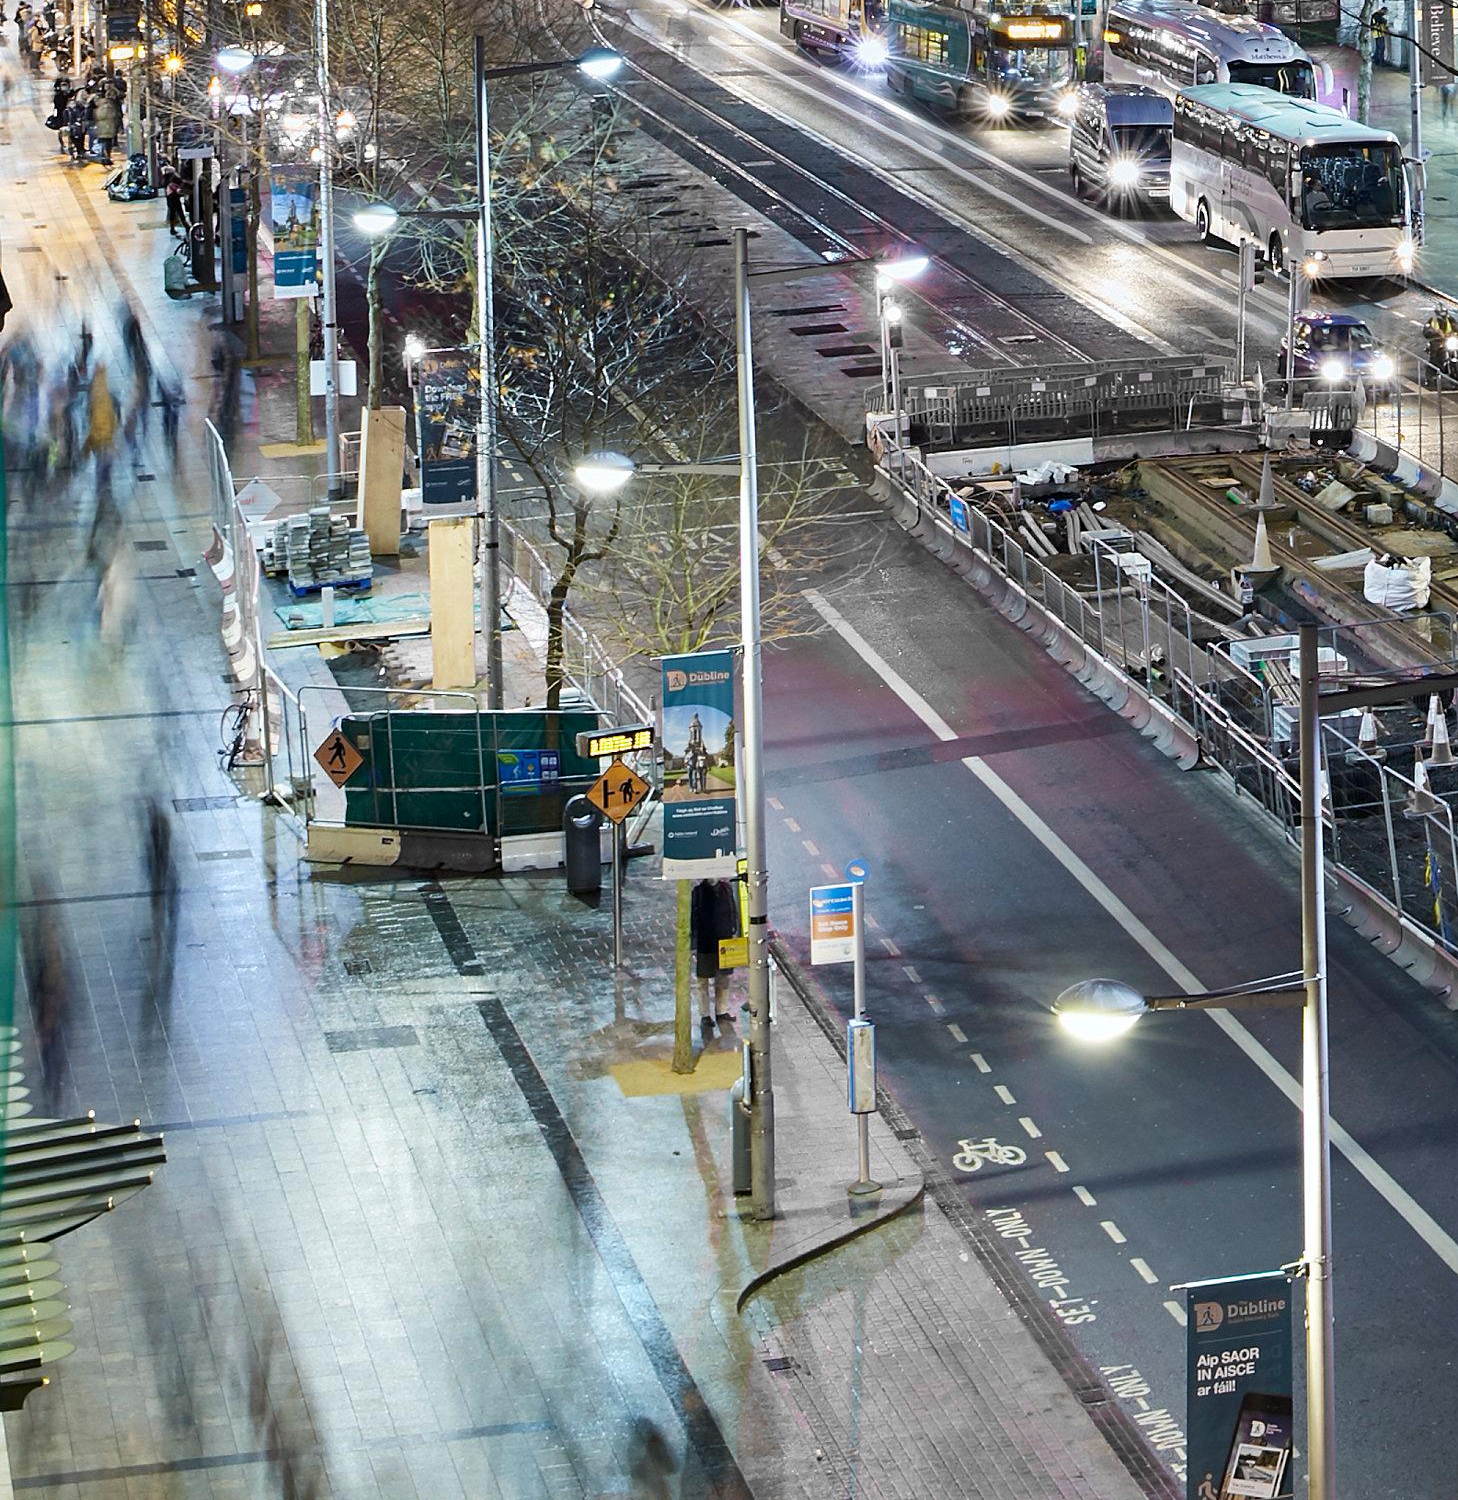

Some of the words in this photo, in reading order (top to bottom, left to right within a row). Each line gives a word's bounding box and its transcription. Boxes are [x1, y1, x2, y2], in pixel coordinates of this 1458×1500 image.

[1227, 1299, 1286, 1318] Dubline
[1196, 1354, 1219, 1367] Aip
[1221, 1347, 1260, 1364] SAOR
[1197, 1368, 1211, 1381] IN
[1214, 1362, 1255, 1380] AISCE
[1197, 1385, 1211, 1396] ar
[1213, 1380, 1236, 1394] fáil!
